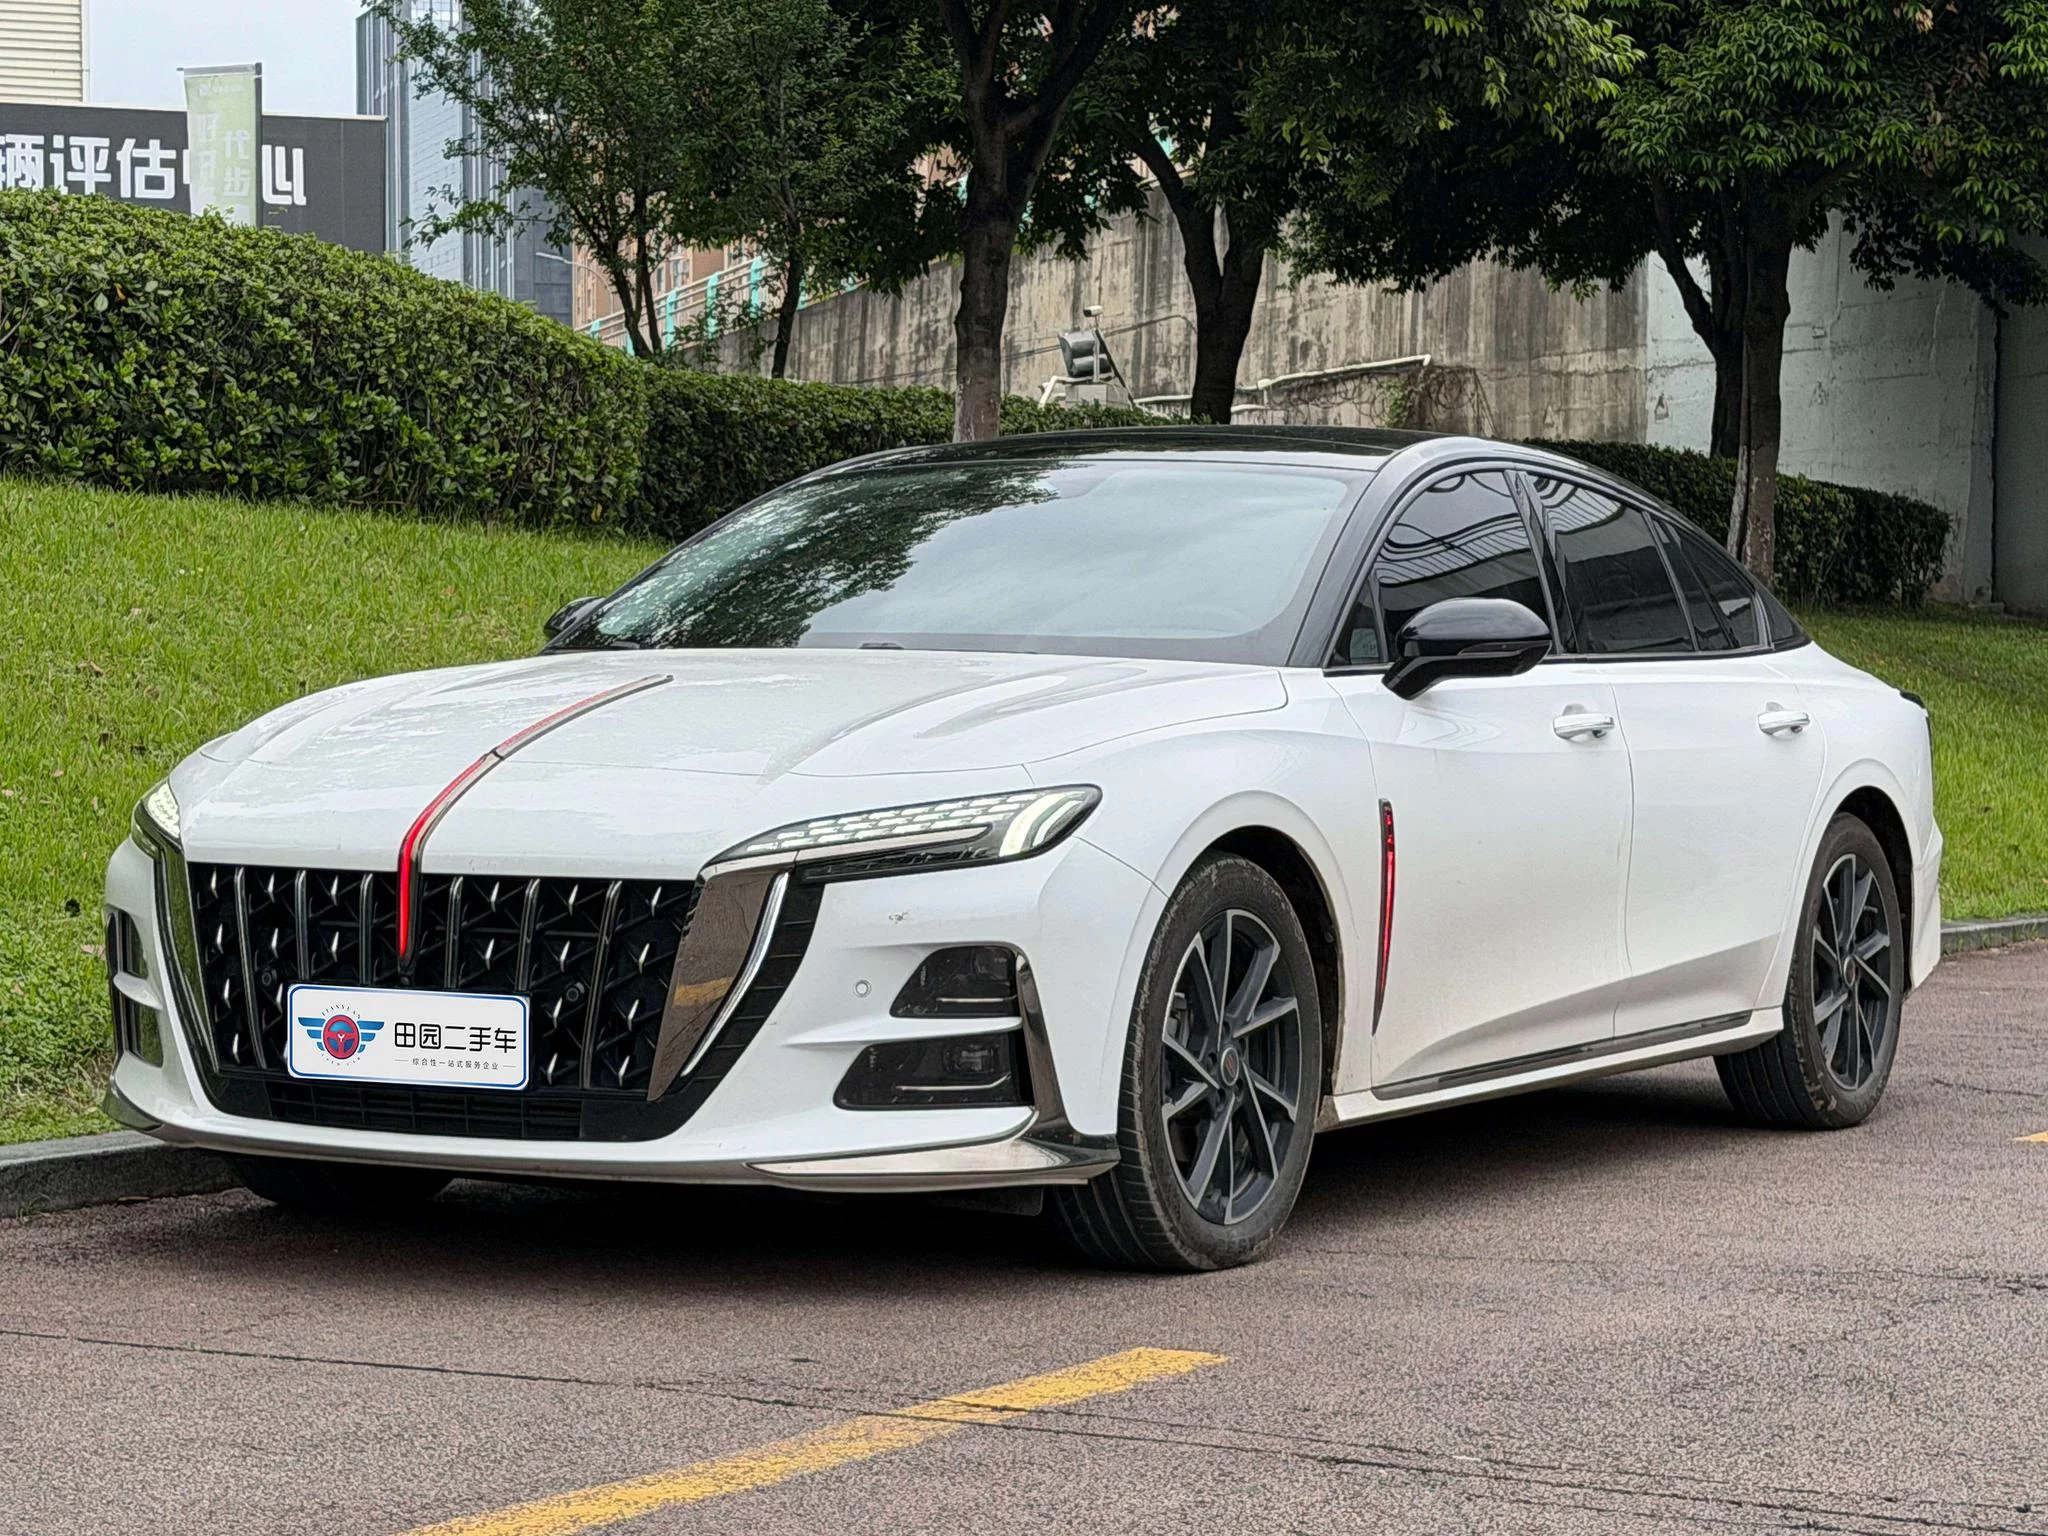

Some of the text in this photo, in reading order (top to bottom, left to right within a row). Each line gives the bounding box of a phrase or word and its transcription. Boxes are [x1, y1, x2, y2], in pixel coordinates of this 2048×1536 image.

[0, 133, 307, 205] 辆评估心
[394, 1022, 517, 1054] 田园二手车
[412, 1057, 499, 1070] 综合性一站式服务企业
